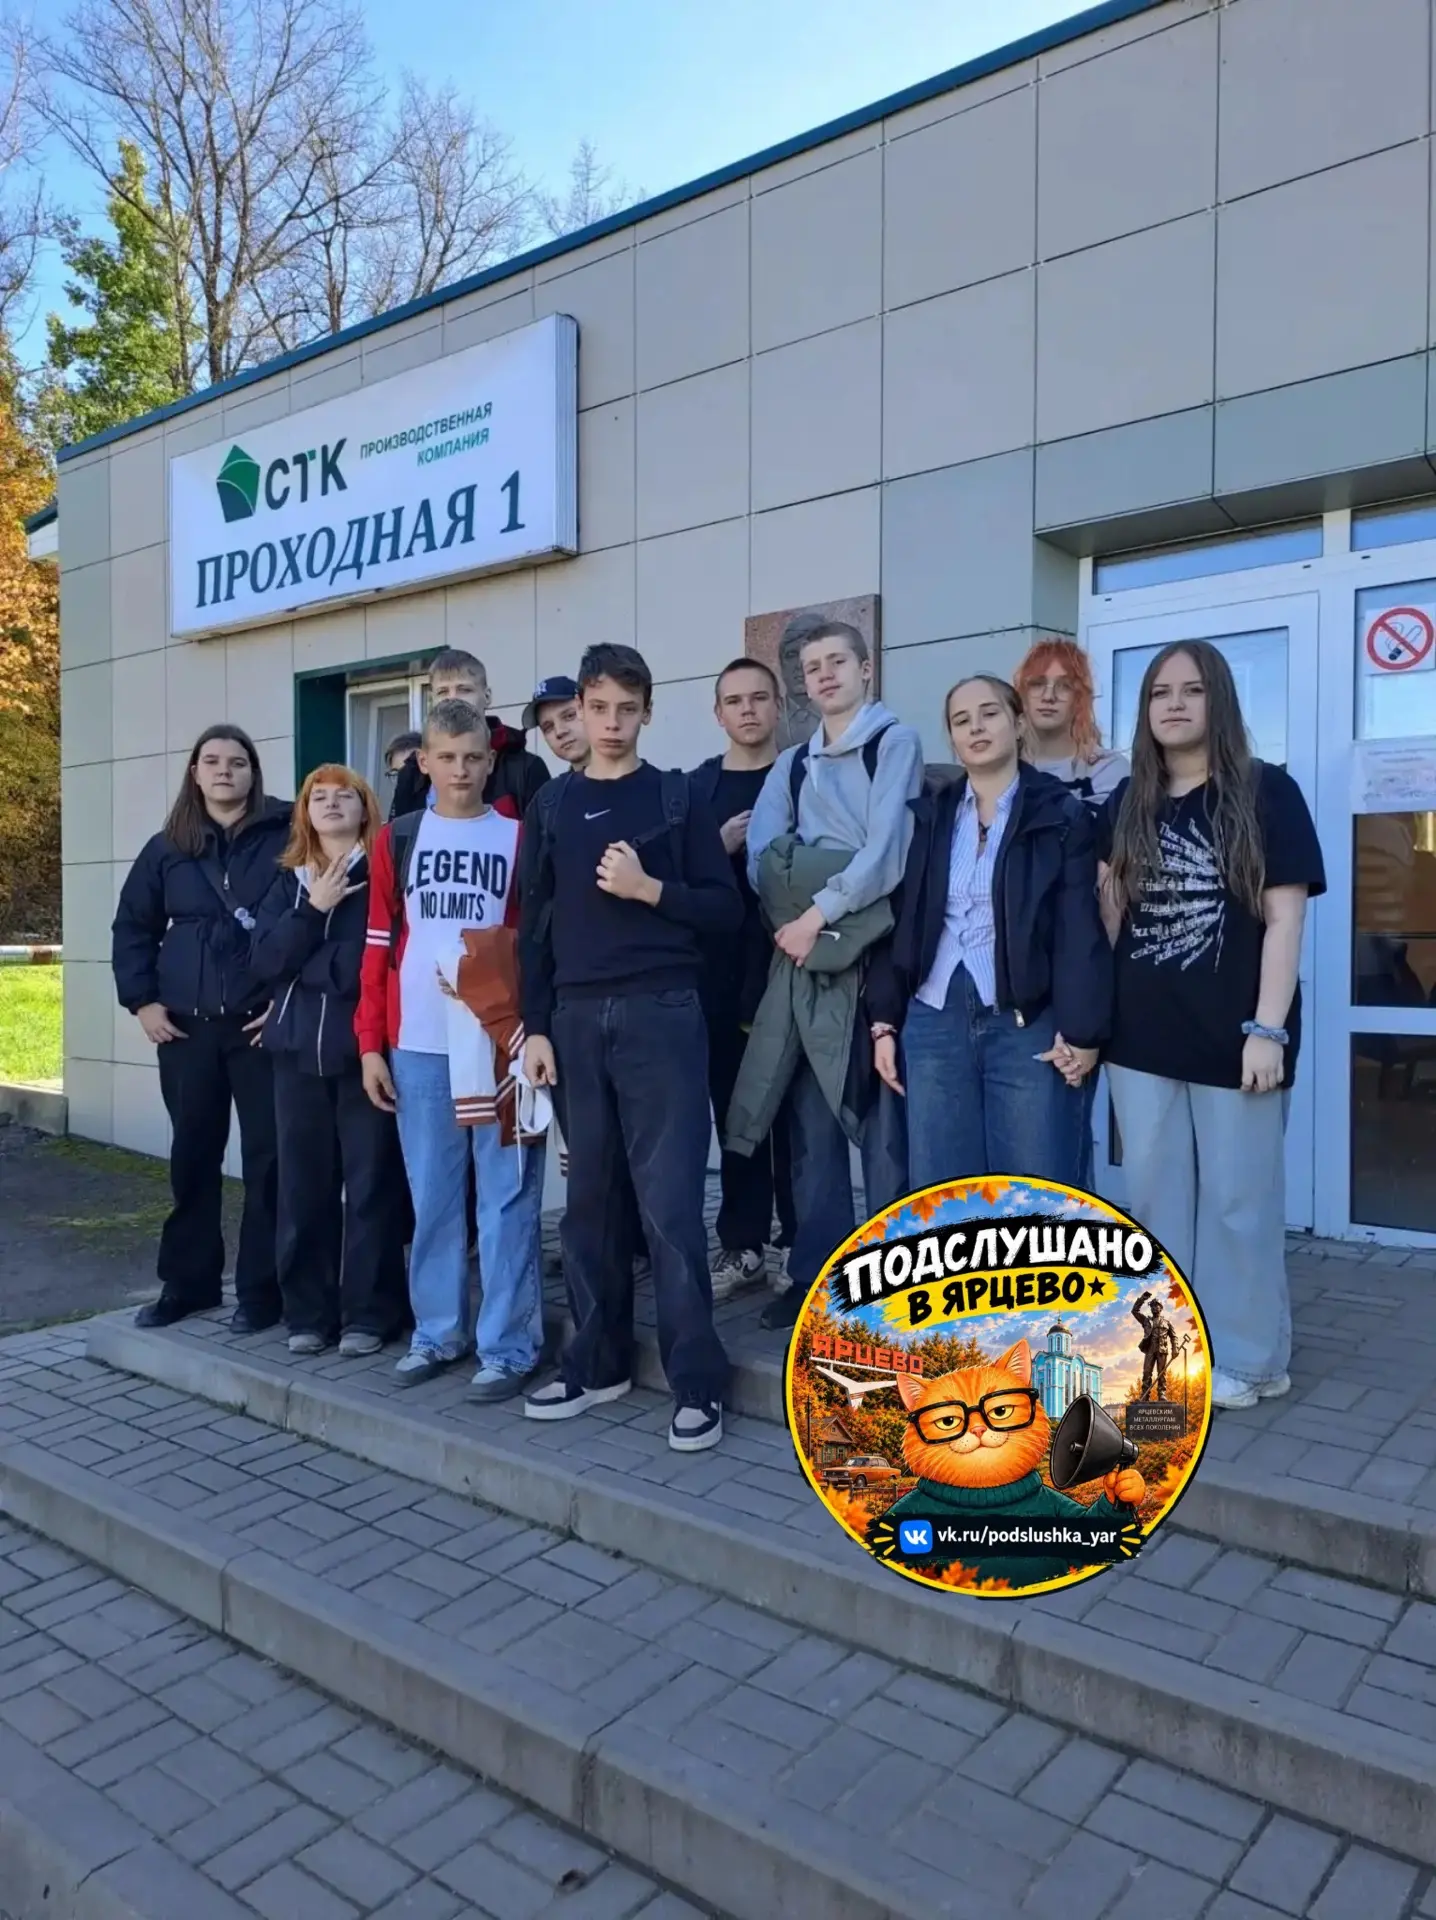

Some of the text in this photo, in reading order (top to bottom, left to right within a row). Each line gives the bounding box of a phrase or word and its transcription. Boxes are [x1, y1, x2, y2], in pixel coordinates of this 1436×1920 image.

[359, 402, 492, 458] ПРОИЗВОДСТВЕННАЯ
[416, 427, 490, 467] КОМПАНИЯ
[264, 437, 349, 512] СТК
[195, 469, 526, 608] ПРОХОДНАЯ 1
[405, 849, 508, 899] EGEND
[420, 892, 485, 922] NO LIMITS
